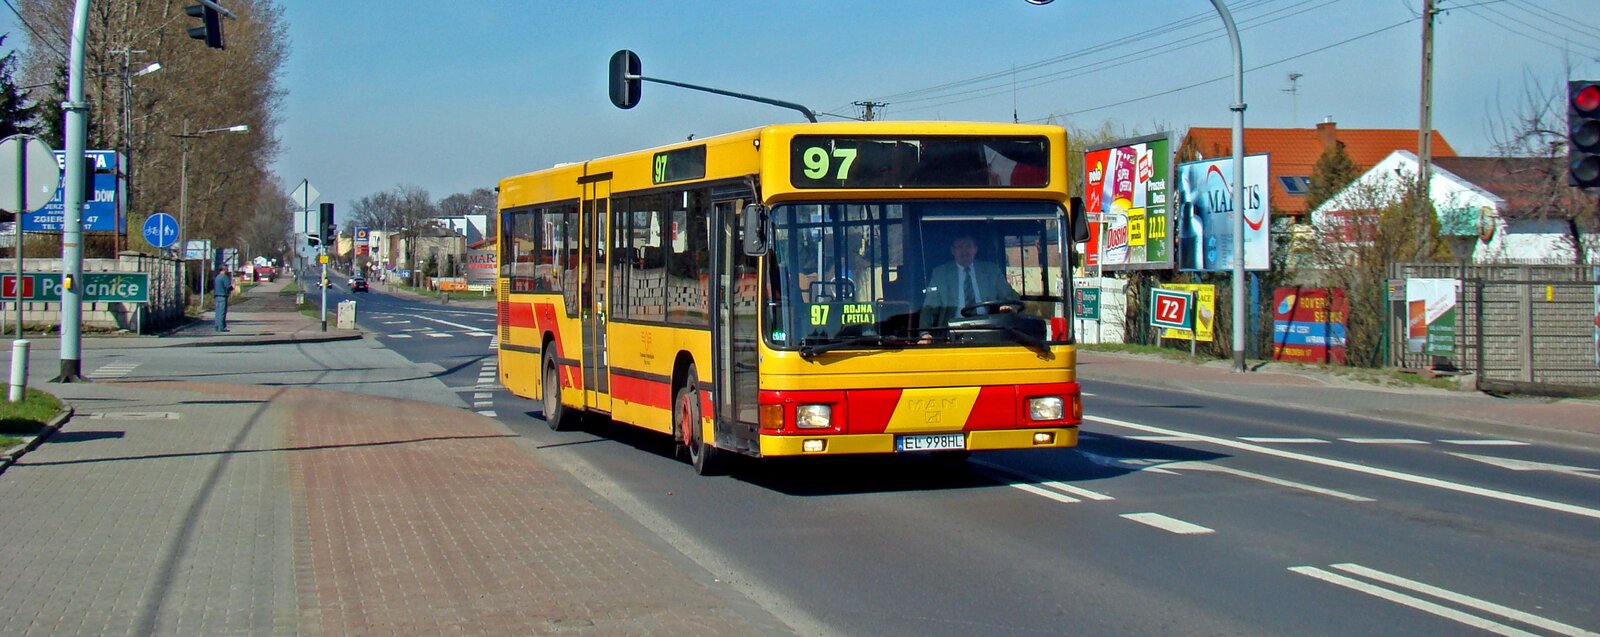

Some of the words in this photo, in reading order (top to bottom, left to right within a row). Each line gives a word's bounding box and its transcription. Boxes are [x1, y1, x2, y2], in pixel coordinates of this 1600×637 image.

[655, 154, 668, 183] 97
[803, 146, 857, 179] 97
[88, 189, 115, 202] DÓW
[1207, 184, 1260, 214] MAIS
[86, 215, 99, 223] 47
[469, 253, 497, 264] MAR
[42, 276, 139, 296] Paanice
[810, 304, 830, 326] 97
[843, 304, 873, 314] ROJNA
[1161, 299, 1180, 319] 72
[908, 398, 958, 410] MAN
[905, 436, 922, 449] EL
[926, 435, 963, 448] 998HL
